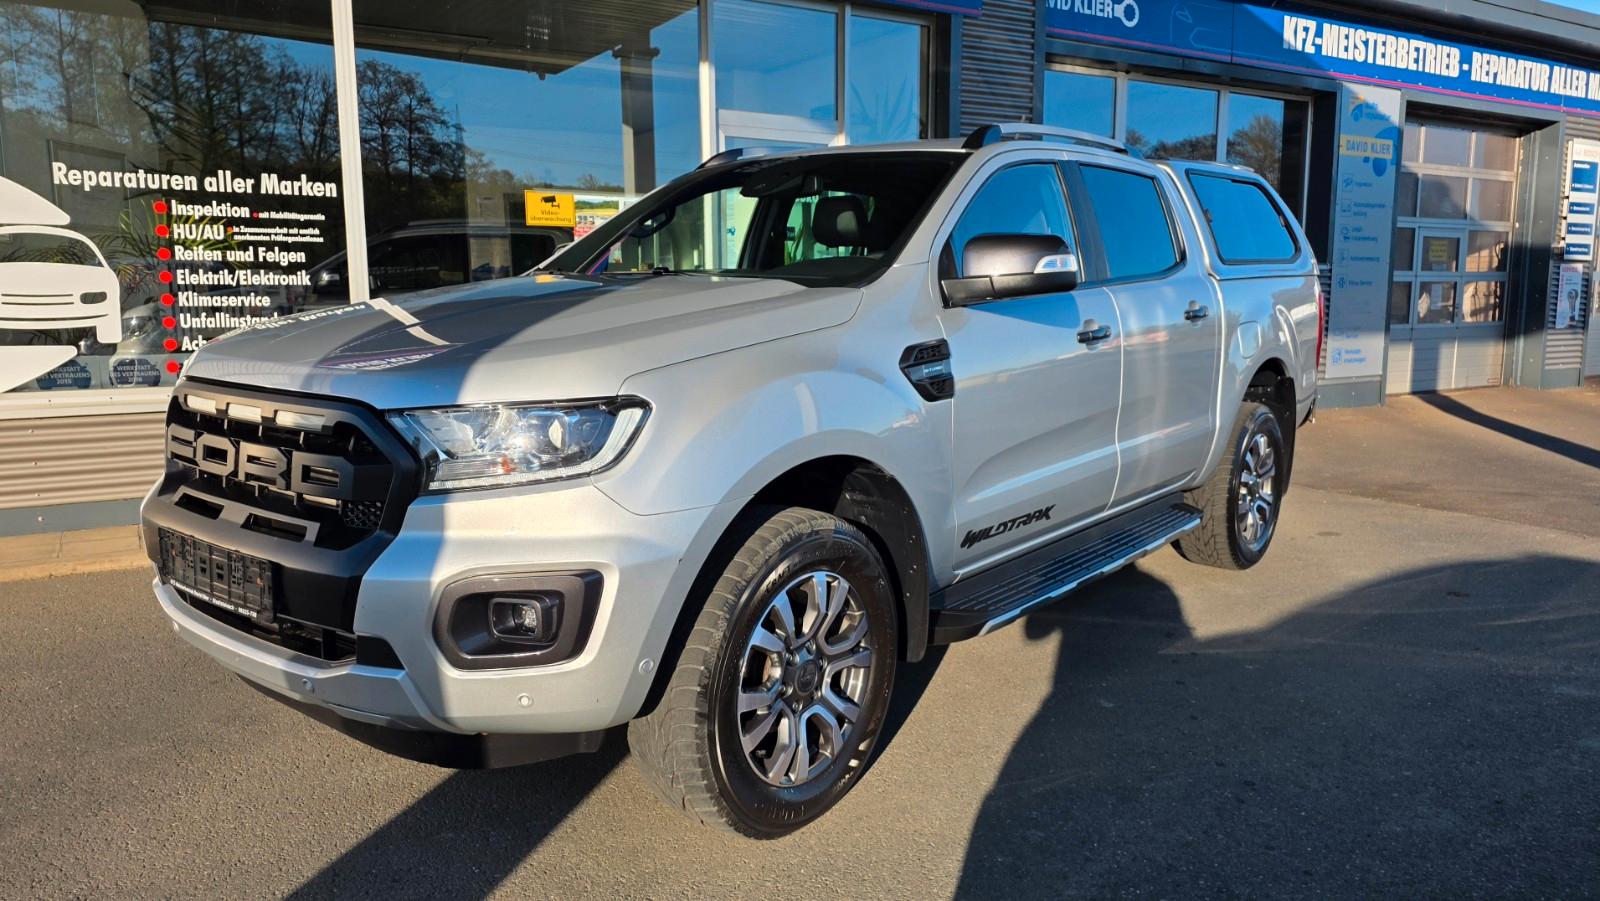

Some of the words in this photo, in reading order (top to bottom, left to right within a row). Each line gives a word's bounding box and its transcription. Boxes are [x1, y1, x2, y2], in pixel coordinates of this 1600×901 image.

[1074, 0, 1113, 19] KLIER
[1283, 15, 1461, 78] KFZ-MEISTERBETRIEB
[1471, 51, 1550, 93] REPARATUR
[1550, 65, 1587, 98] ALLER
[1588, 72, 1600, 101] M
[1346, 139, 1368, 153] DAVID
[1371, 141, 1391, 155] KLIER
[52, 161, 198, 191] Reparaturen
[204, 169, 254, 194] aller
[260, 173, 337, 198] Marken
[171, 200, 250, 219] Inspektion
[173, 223, 224, 241] HU/AU
[174, 245, 222, 261] Reifen
[226, 245, 254, 262] und
[258, 246, 306, 267] Felgen
[176, 268, 312, 287] Elektrik/Elektronik
[178, 291, 271, 307] Klimaservice
[960, 504, 1056, 549] WILDTRAK
